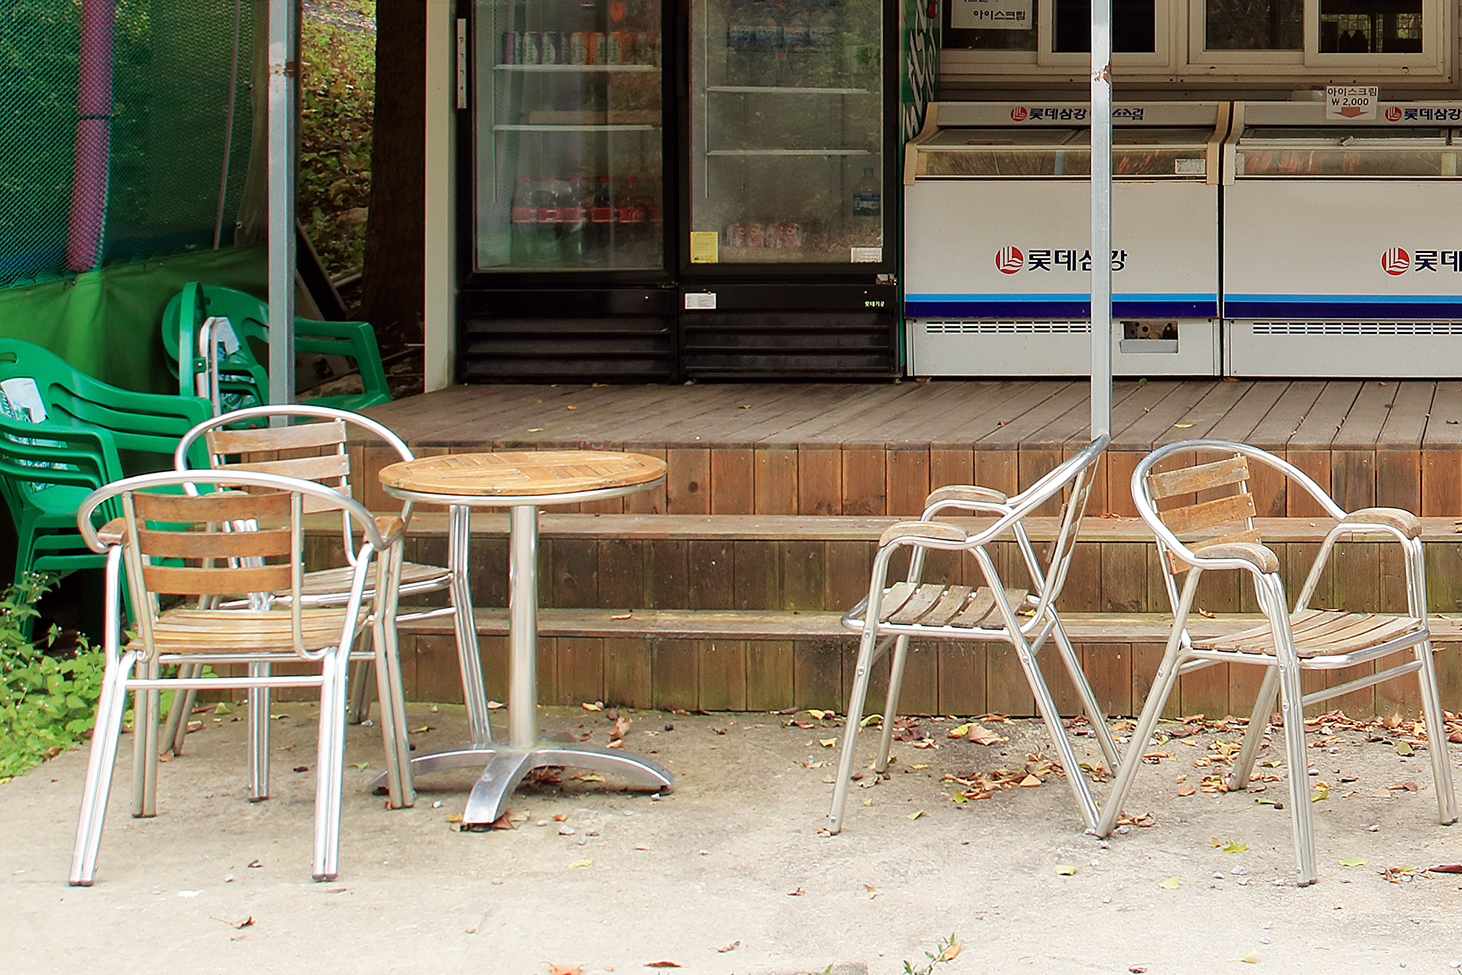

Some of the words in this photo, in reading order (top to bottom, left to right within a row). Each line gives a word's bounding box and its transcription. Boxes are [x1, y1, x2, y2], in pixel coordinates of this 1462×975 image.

[973, 10, 1026, 21] 아이스크림
[1327, 87, 1378, 97] 아이스크림
[1342, 97, 1369, 106] 2,000
[1029, 108, 1087, 121] 롯데삼강
[1404, 108, 1462, 121] 롯데삼강
